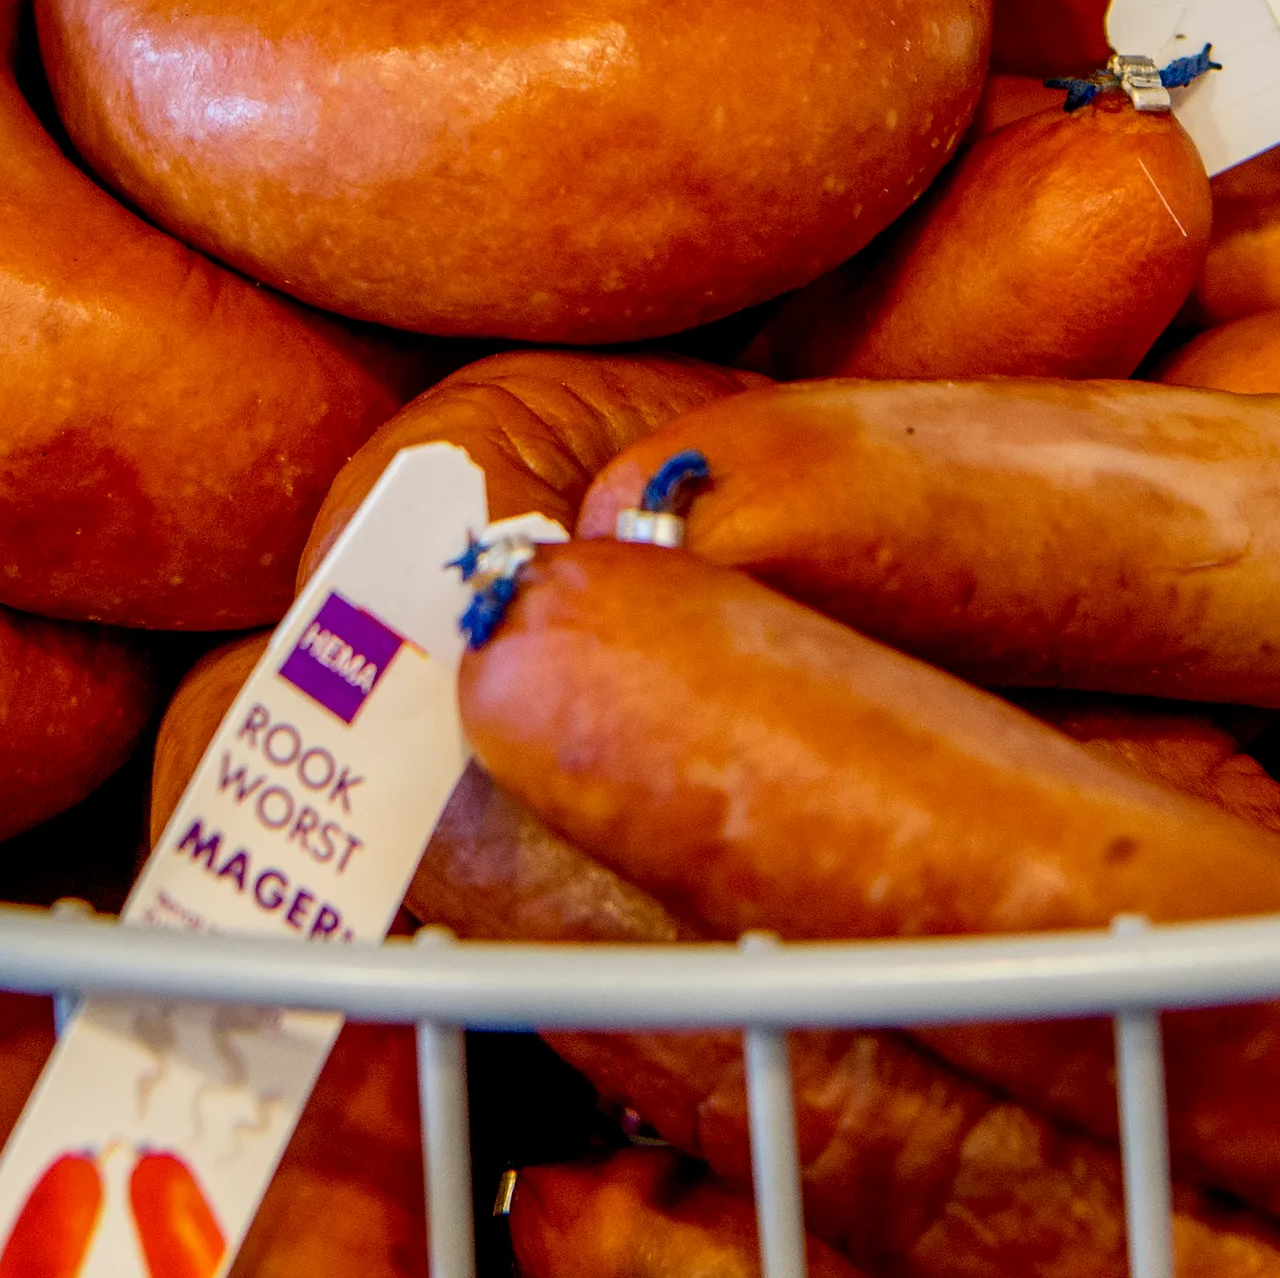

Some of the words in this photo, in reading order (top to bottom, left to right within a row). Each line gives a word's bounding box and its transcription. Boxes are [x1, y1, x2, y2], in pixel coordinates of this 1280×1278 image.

[299, 621, 378, 695] HEMA
[217, 749, 363, 875] WORST
[237, 702, 365, 815] ROOK
